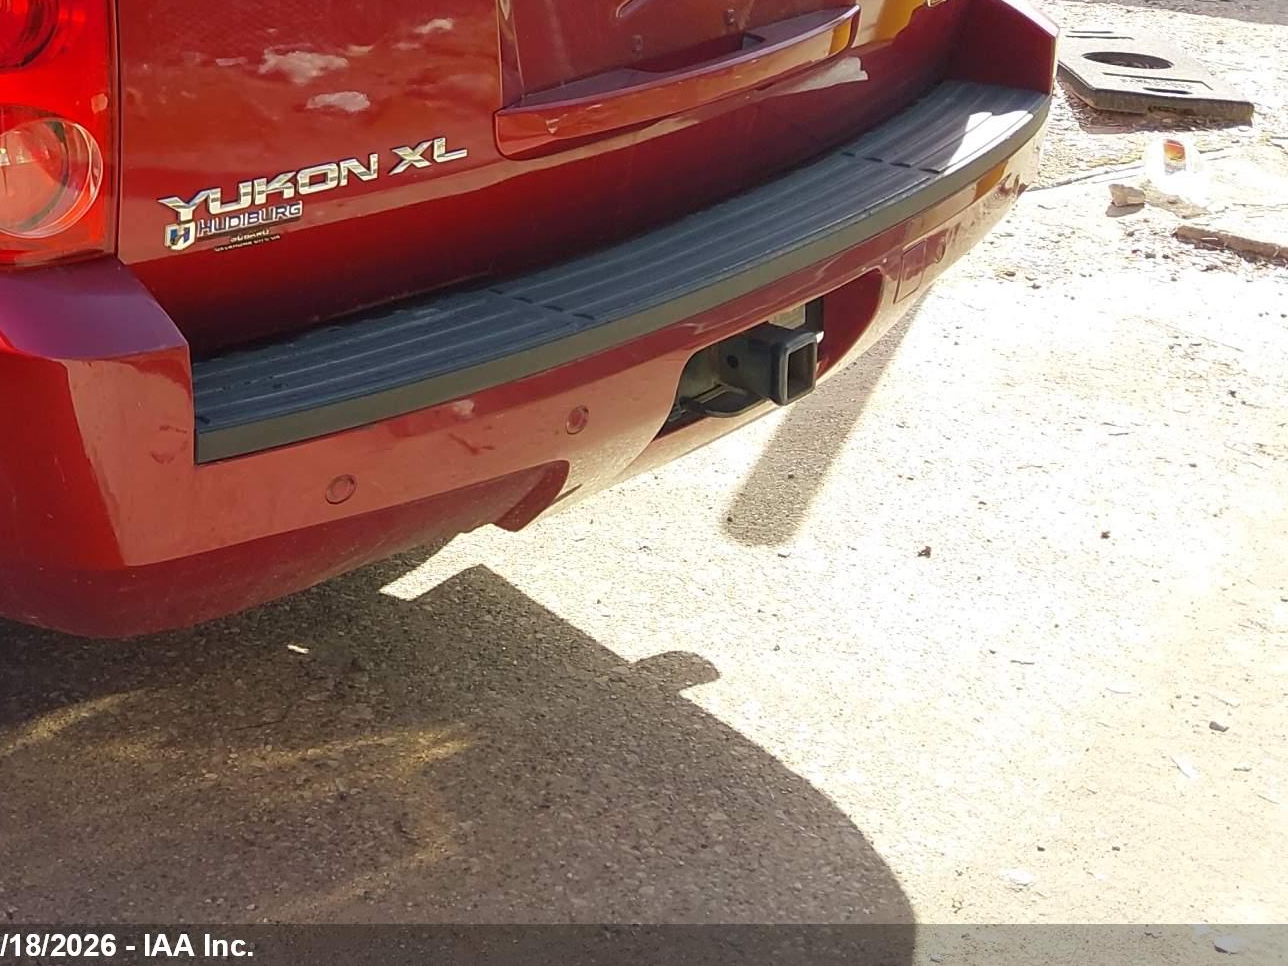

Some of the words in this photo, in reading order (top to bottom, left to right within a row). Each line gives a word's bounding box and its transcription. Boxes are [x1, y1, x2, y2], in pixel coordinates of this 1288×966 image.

[158, 153, 378, 222] YUKON
[388, 137, 468, 175] XL
[196, 200, 303, 237] HUDIBURG
